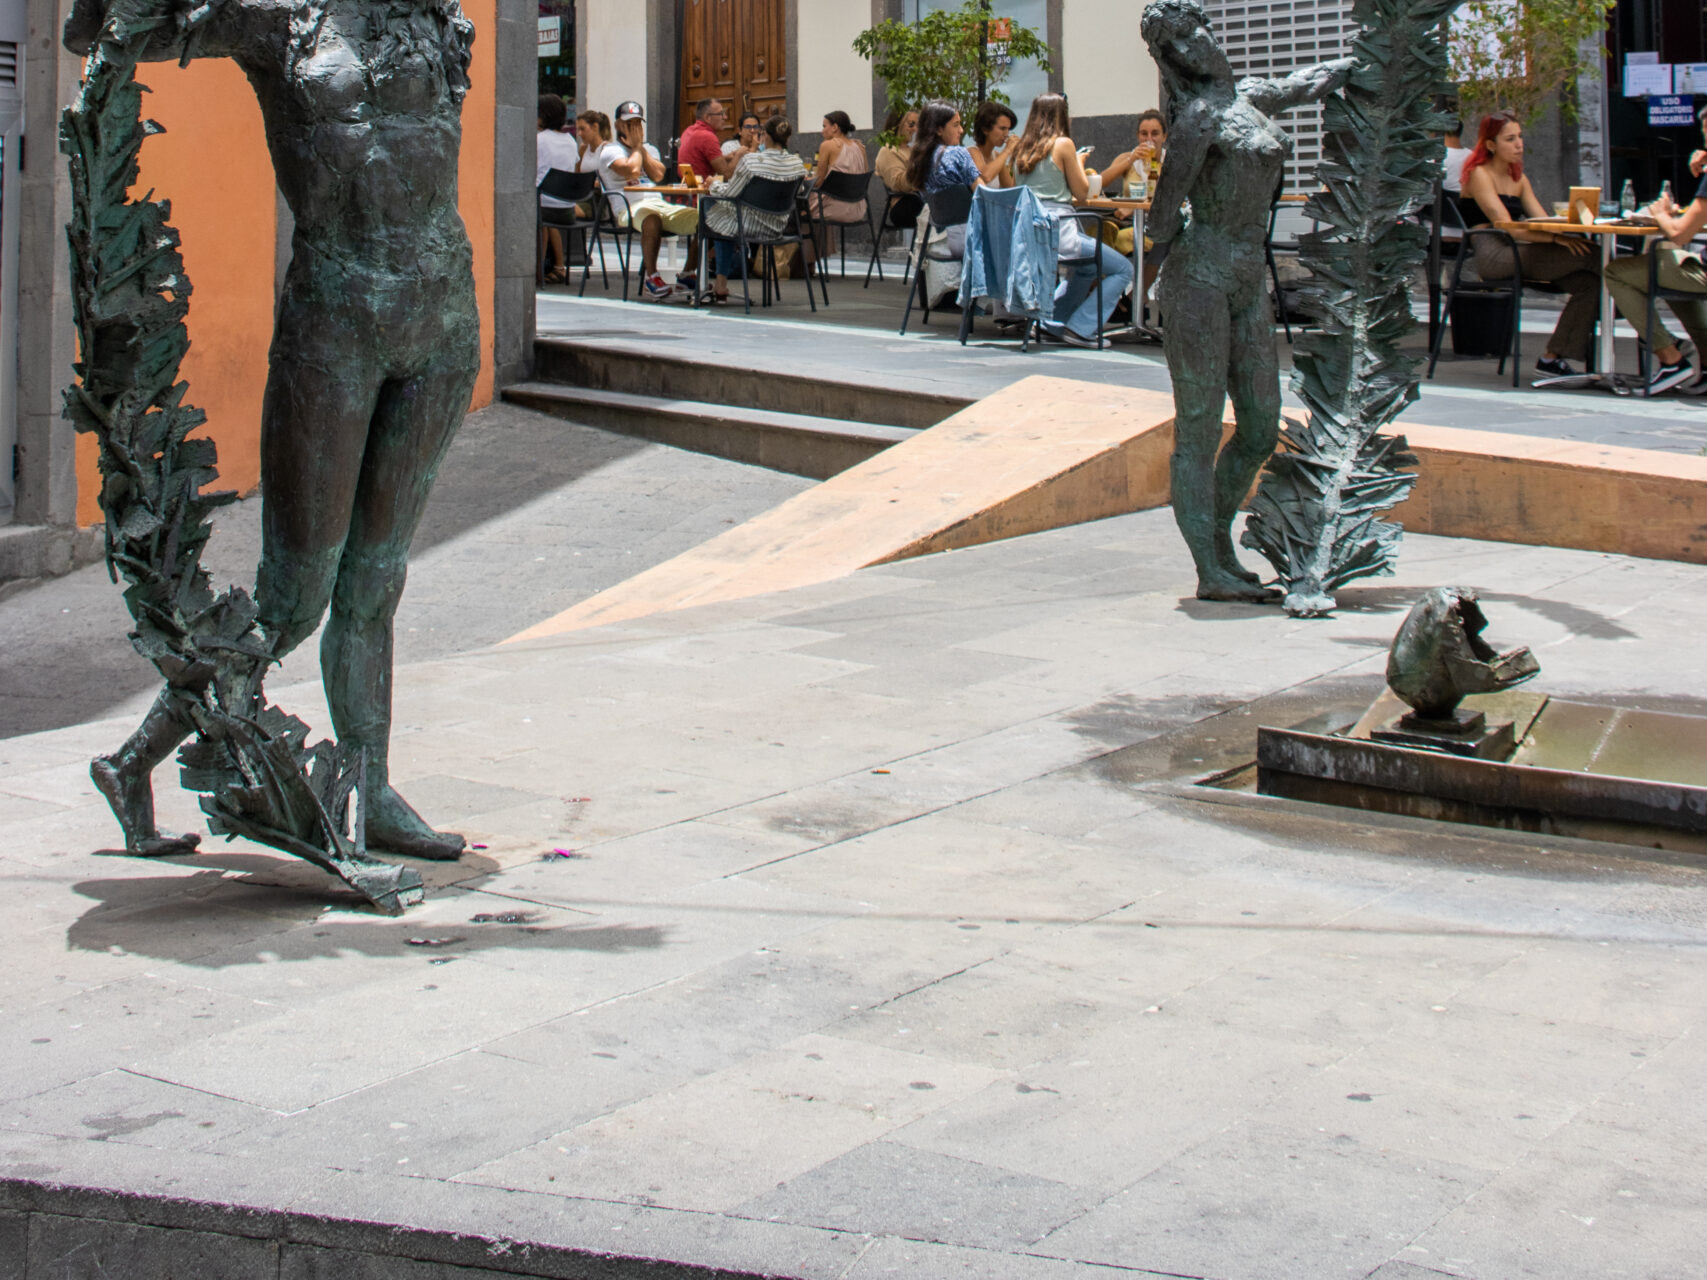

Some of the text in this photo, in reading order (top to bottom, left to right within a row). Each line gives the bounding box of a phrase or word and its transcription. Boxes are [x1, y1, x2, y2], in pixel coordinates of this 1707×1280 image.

[1661, 97, 1680, 105] USO
[1650, 106, 1694, 114] OBLIGATORIO
[1650, 115, 1694, 124] MASCARILLA
